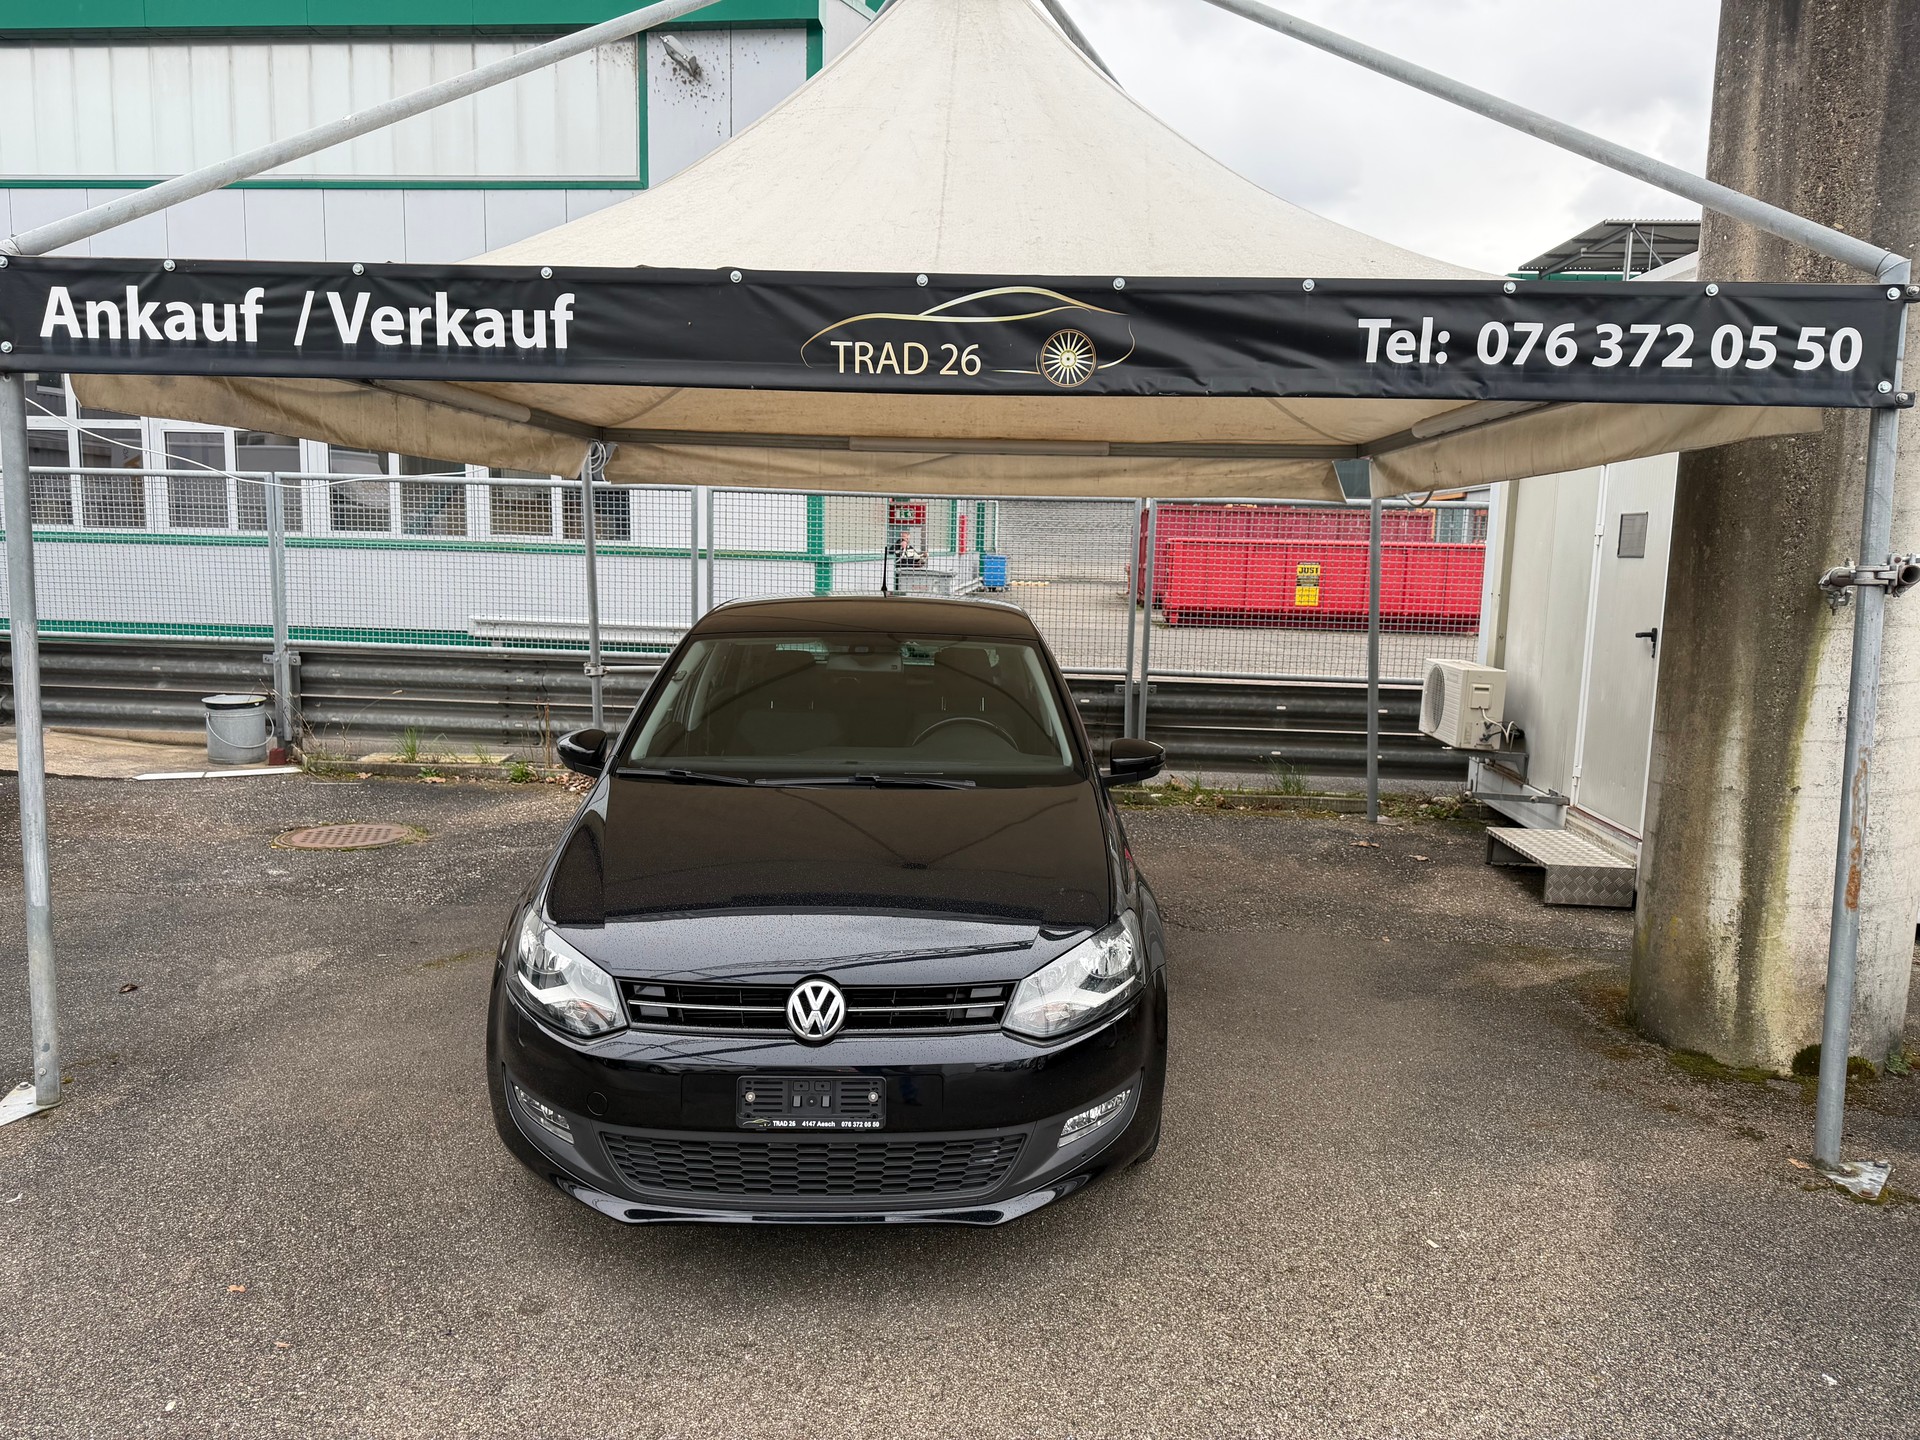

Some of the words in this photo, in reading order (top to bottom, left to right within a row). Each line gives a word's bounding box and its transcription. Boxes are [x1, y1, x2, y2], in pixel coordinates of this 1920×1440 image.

[39, 285, 265, 343] Ankauf
[829, 340, 929, 375] TRAD
[940, 343, 982, 376] 26
[1357, 316, 1451, 365] Tel:
[1476, 321, 1578, 367] 076
[1591, 323, 1695, 368] 372
[1710, 323, 1778, 370] 05
[1792, 326, 1863, 372] 50
